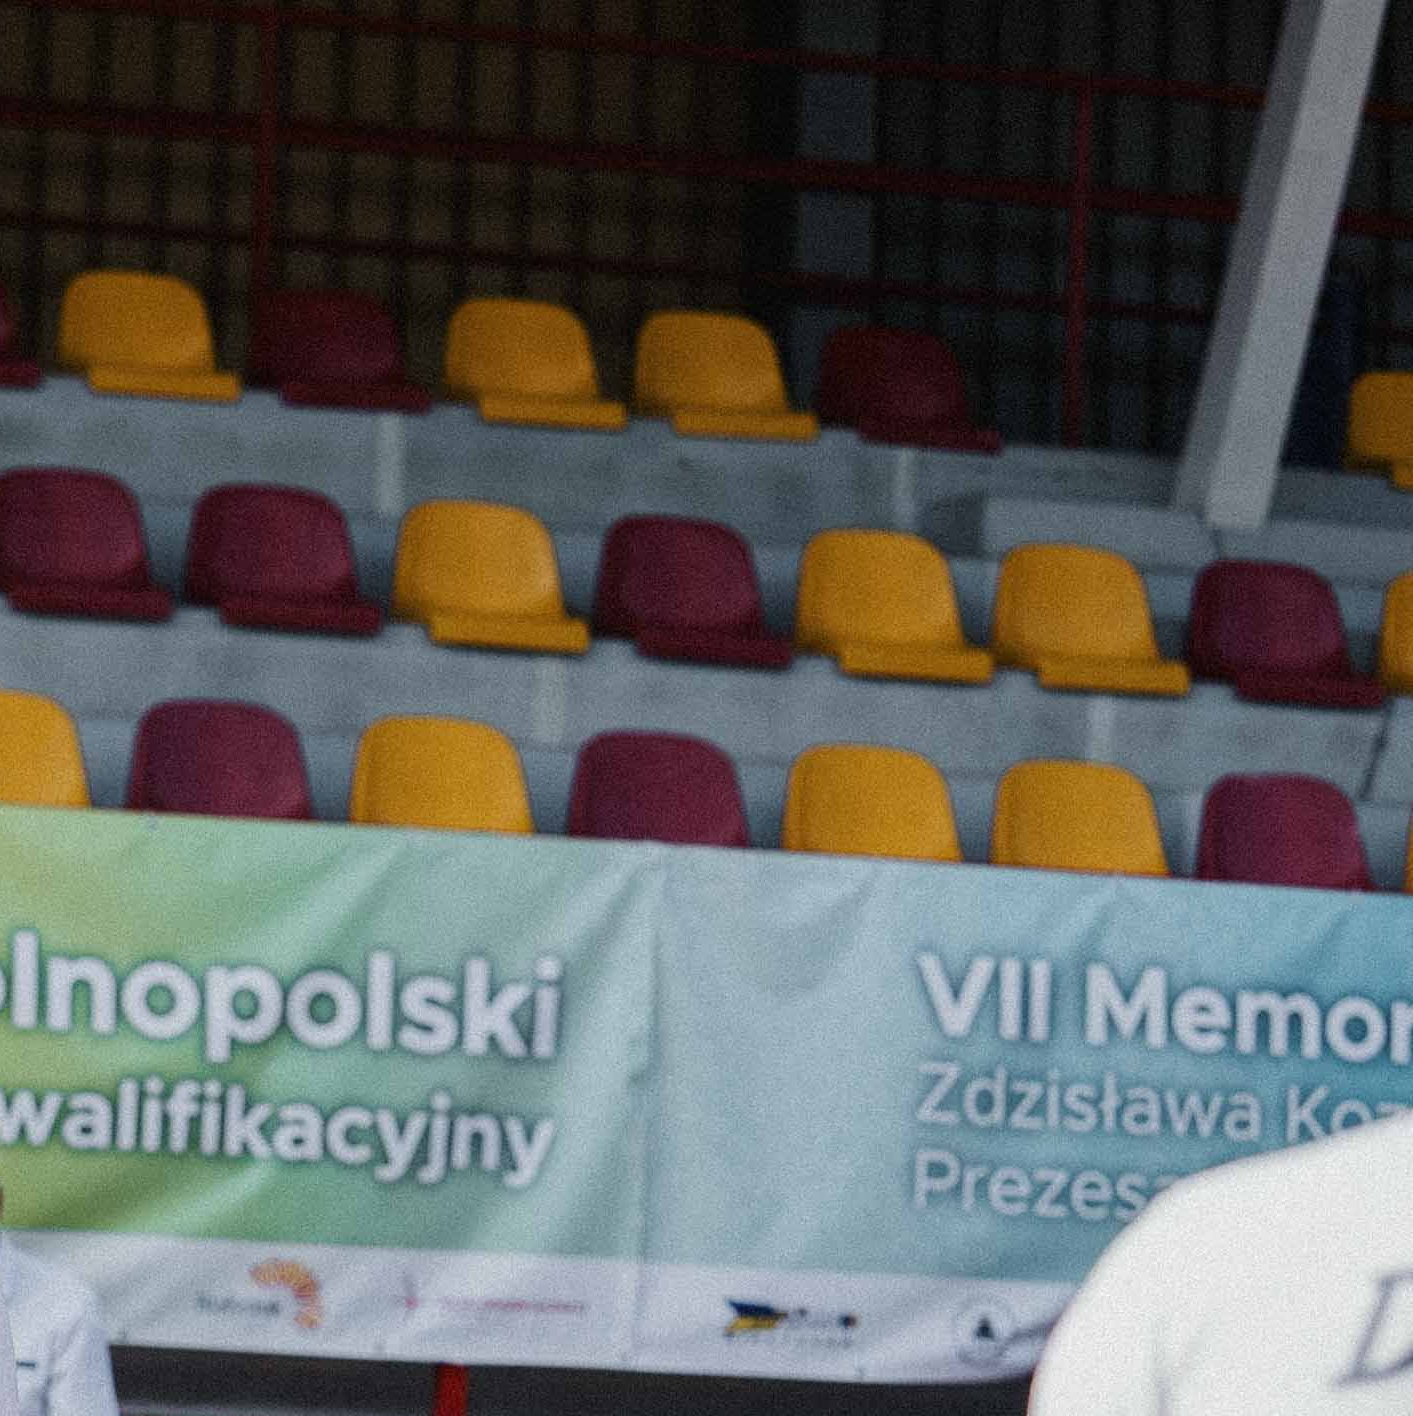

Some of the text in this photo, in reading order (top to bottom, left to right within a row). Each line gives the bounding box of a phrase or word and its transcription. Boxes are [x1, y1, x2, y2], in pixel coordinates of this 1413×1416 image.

[915, 951, 1051, 1042] VII
[914, 1060, 1263, 1142] Zdzisława
[915, 1150, 1177, 1222] Prezes
